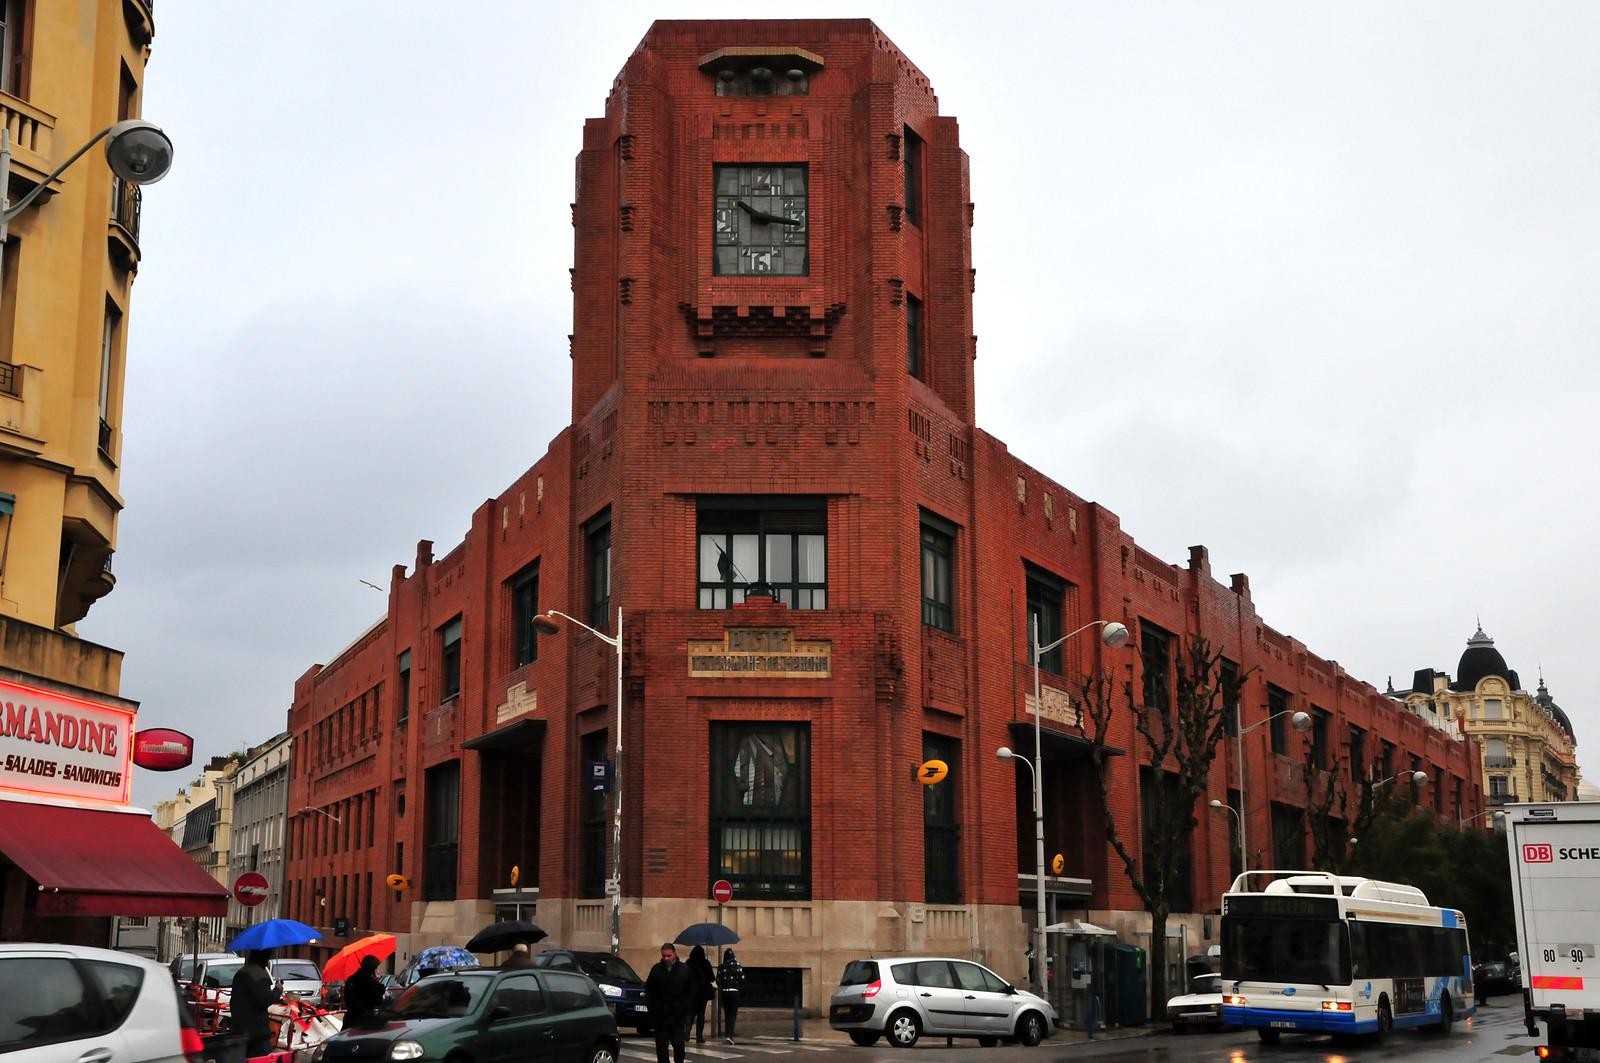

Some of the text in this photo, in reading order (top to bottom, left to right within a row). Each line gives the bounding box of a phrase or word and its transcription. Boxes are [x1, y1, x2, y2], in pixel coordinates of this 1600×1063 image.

[0, 701, 117, 757] MANDINE
[5, 754, 57, 778] SALADES
[63, 764, 122, 787] SANDWICHS
[1526, 846, 1600, 861] DB SCHE
[1543, 949, 1556, 962] 80
[1571, 949, 1584, 962] 90
